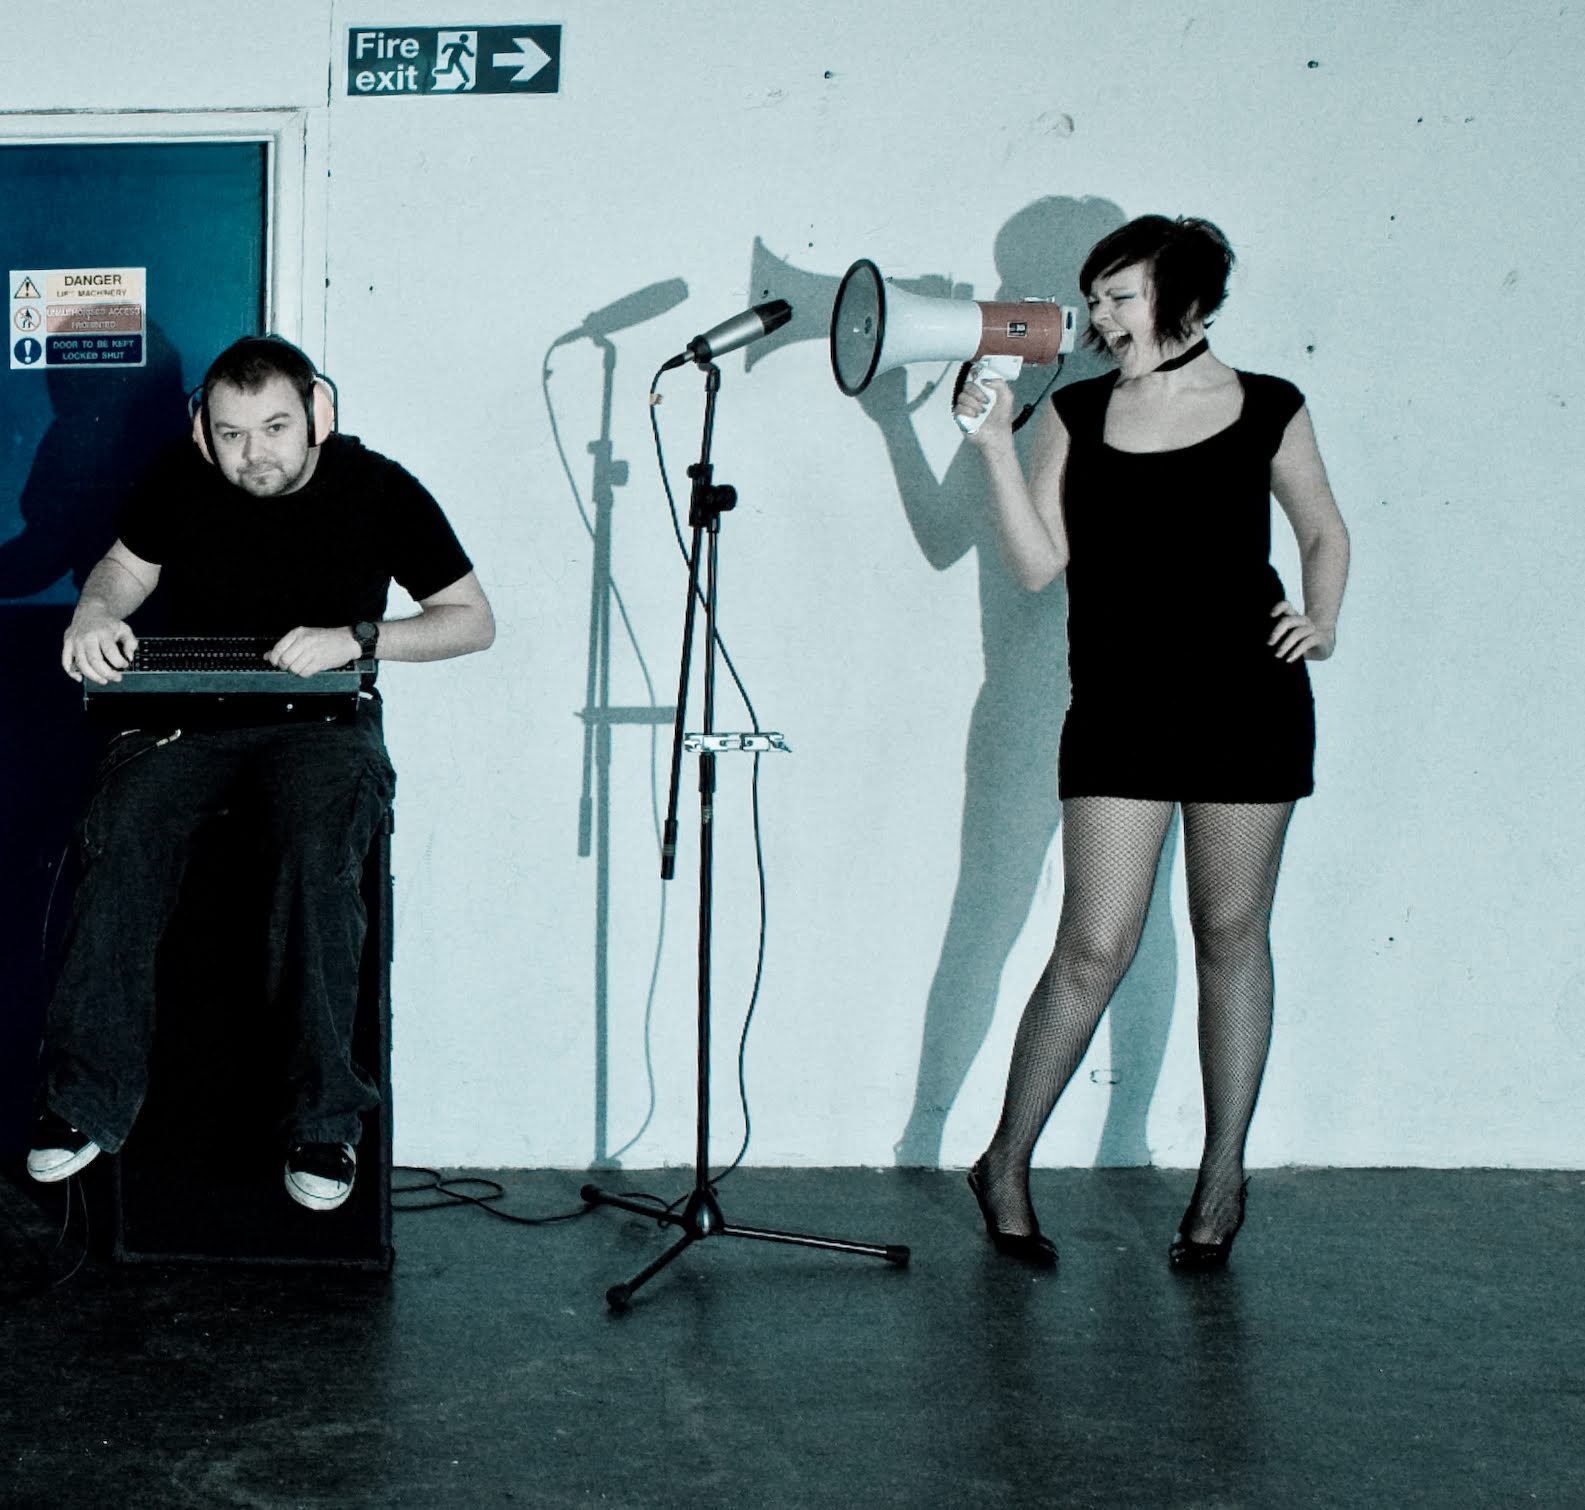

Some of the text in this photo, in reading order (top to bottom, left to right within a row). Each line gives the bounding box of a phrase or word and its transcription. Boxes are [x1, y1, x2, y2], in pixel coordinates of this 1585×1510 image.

[356, 32, 419, 59] Fire
[356, 64, 418, 91] exit
[64, 274, 122, 286] DANGER
[53, 339, 134, 349] DOOR TO BE KEPT
[62, 351, 125, 361] LOCKED SHUT
